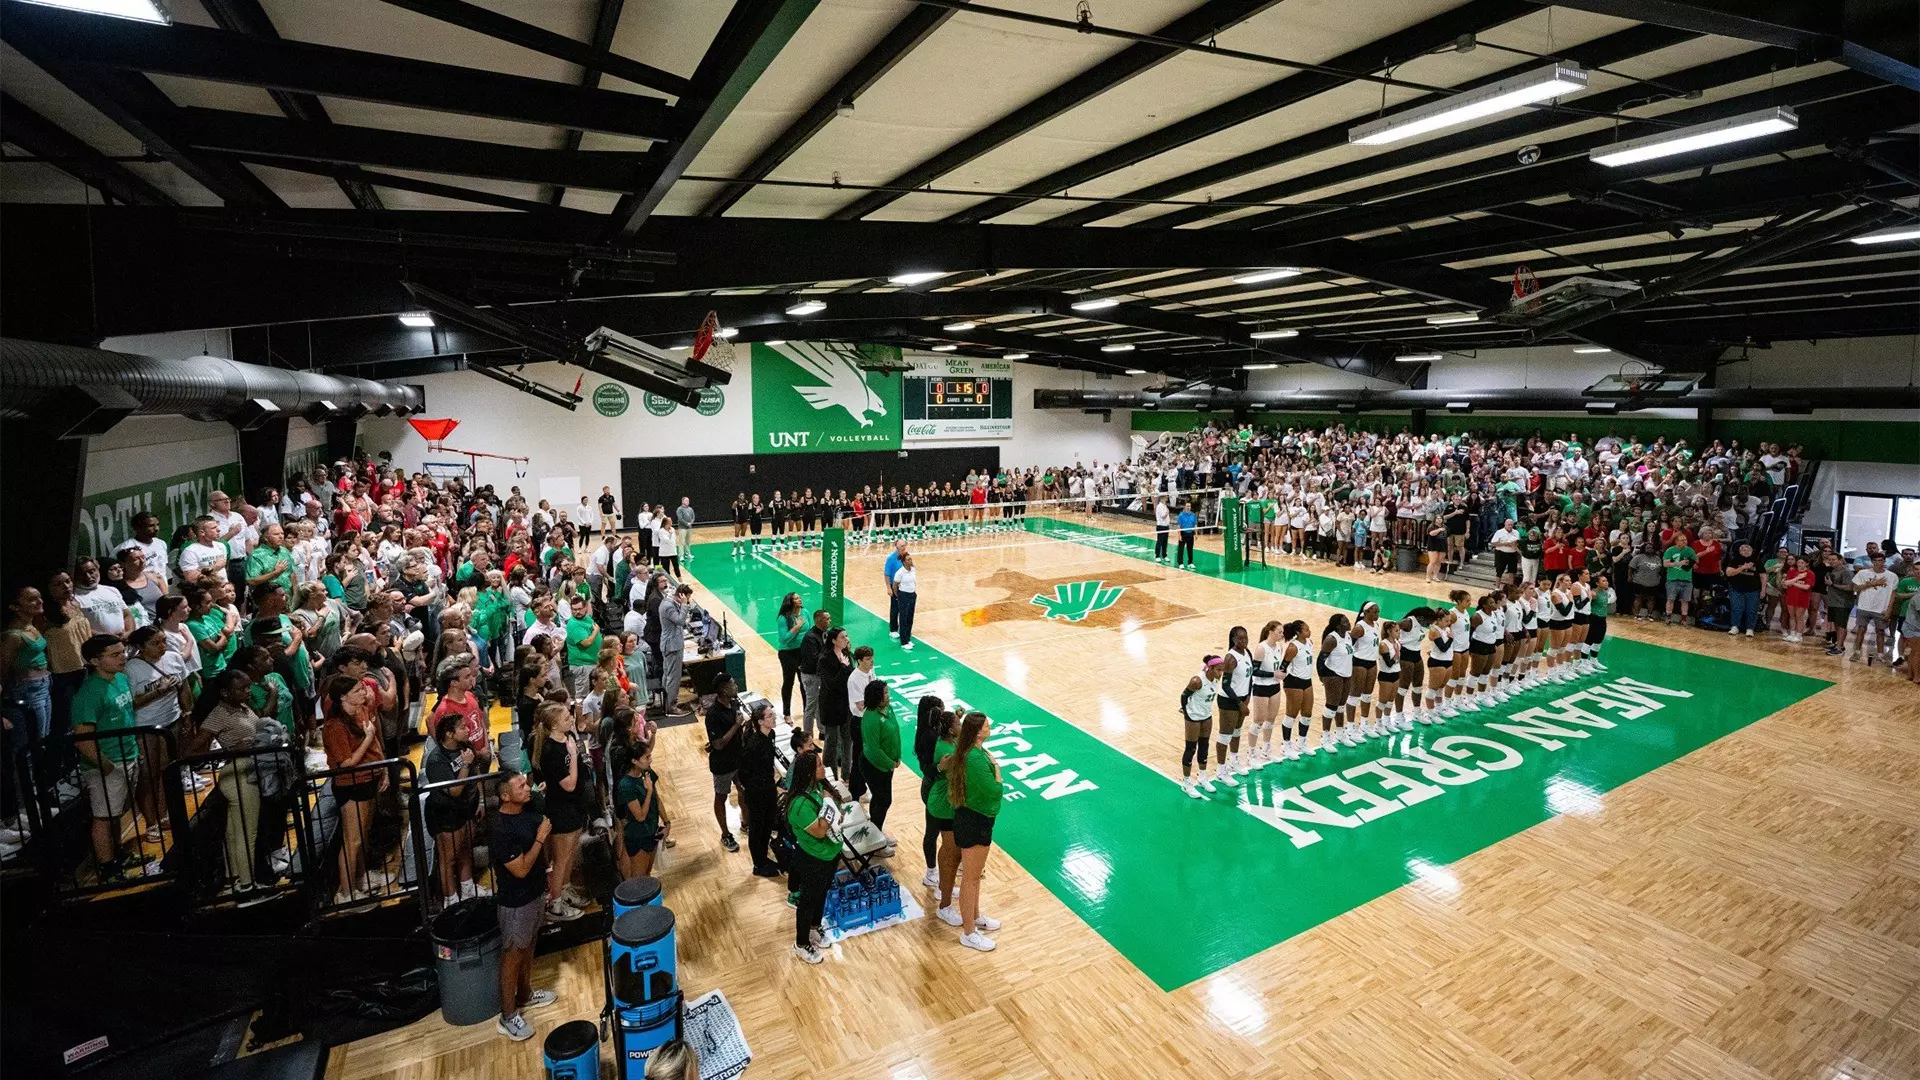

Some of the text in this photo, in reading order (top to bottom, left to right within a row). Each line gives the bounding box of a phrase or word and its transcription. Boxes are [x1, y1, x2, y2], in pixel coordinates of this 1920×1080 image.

[945, 359, 969, 367] MEAN
[981, 362, 1011, 370] AMERICAN
[949, 366, 974, 374] GREEN
[937, 384, 943, 393] 0
[982, 383, 988, 393] 0
[937, 394, 943, 404] 0
[977, 394, 983, 404] 0
[769, 431, 890, 448] UNT VOLLEYBALL
[830, 548, 839, 598] NORTH TEXAS
[1484, 676, 1694, 752] MEAN
[1236, 735, 1524, 849] GREEN
